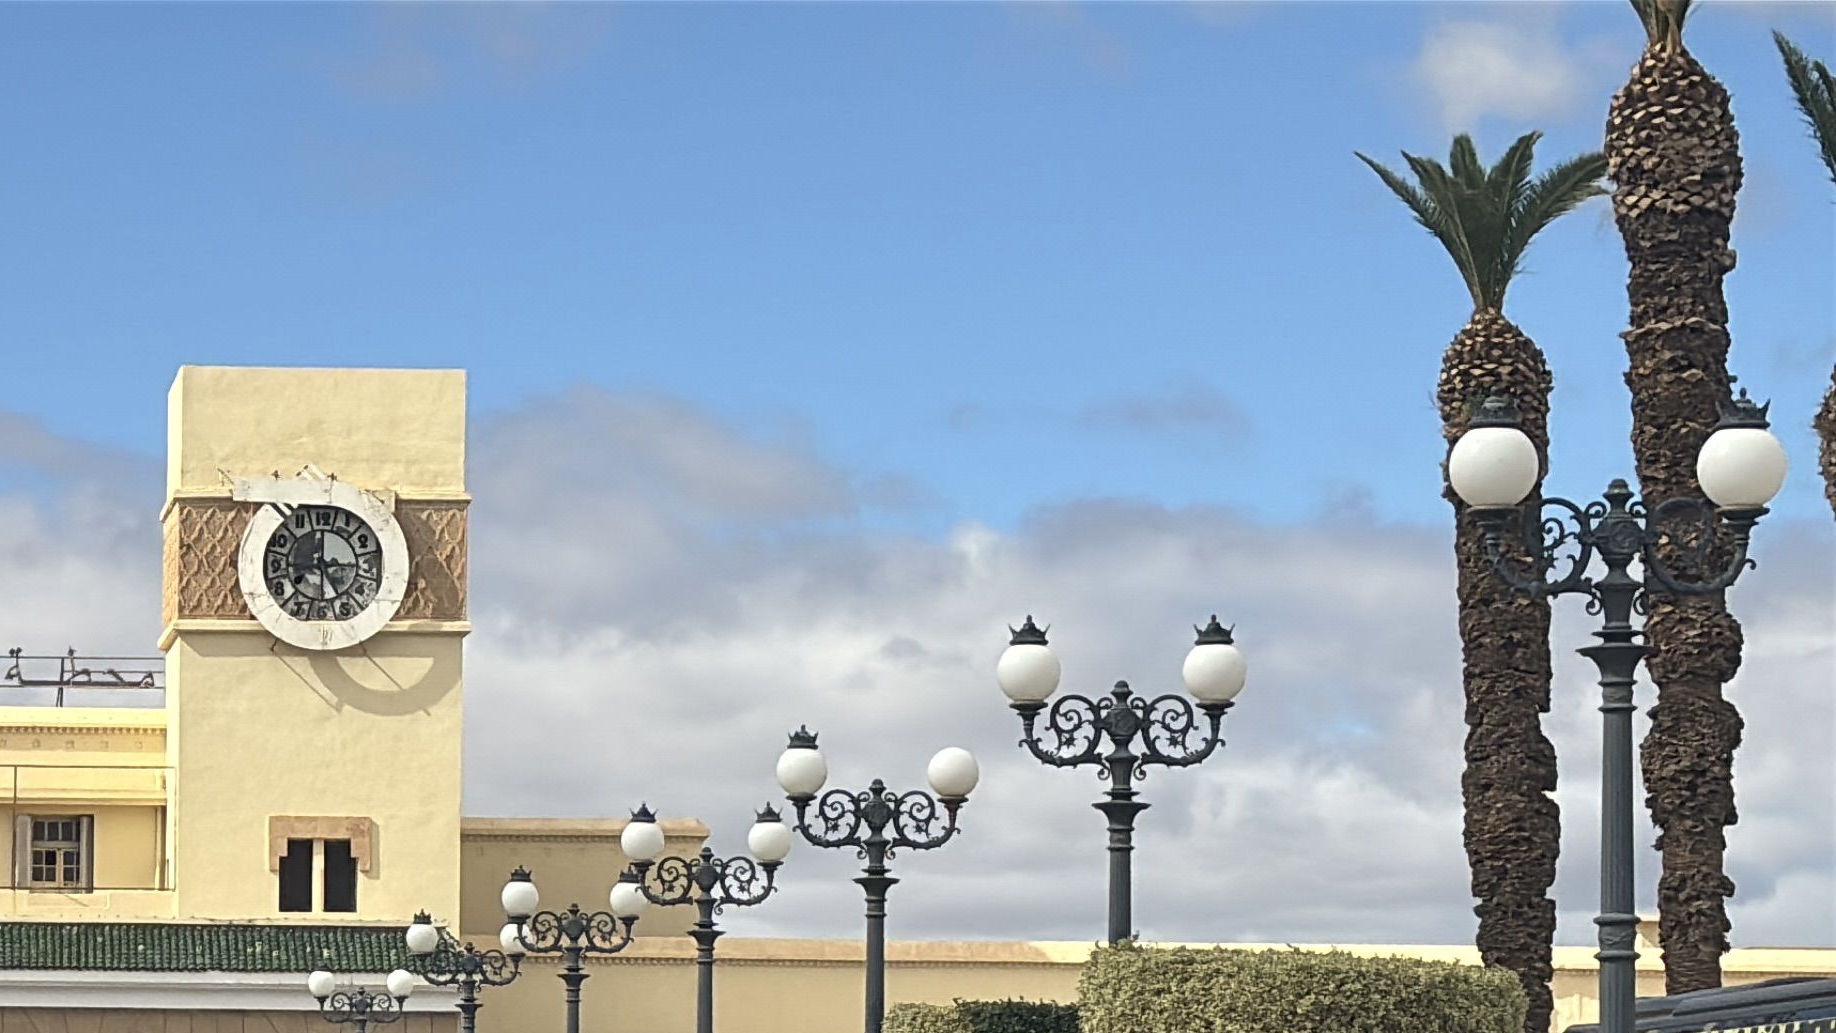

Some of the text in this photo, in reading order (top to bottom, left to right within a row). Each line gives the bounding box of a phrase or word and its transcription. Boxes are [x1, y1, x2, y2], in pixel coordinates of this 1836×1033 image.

[295, 513, 305, 529] 11
[315, 511, 331, 526] 12
[274, 581, 285, 597] 8
[5, 646, 155, 689] محطة
